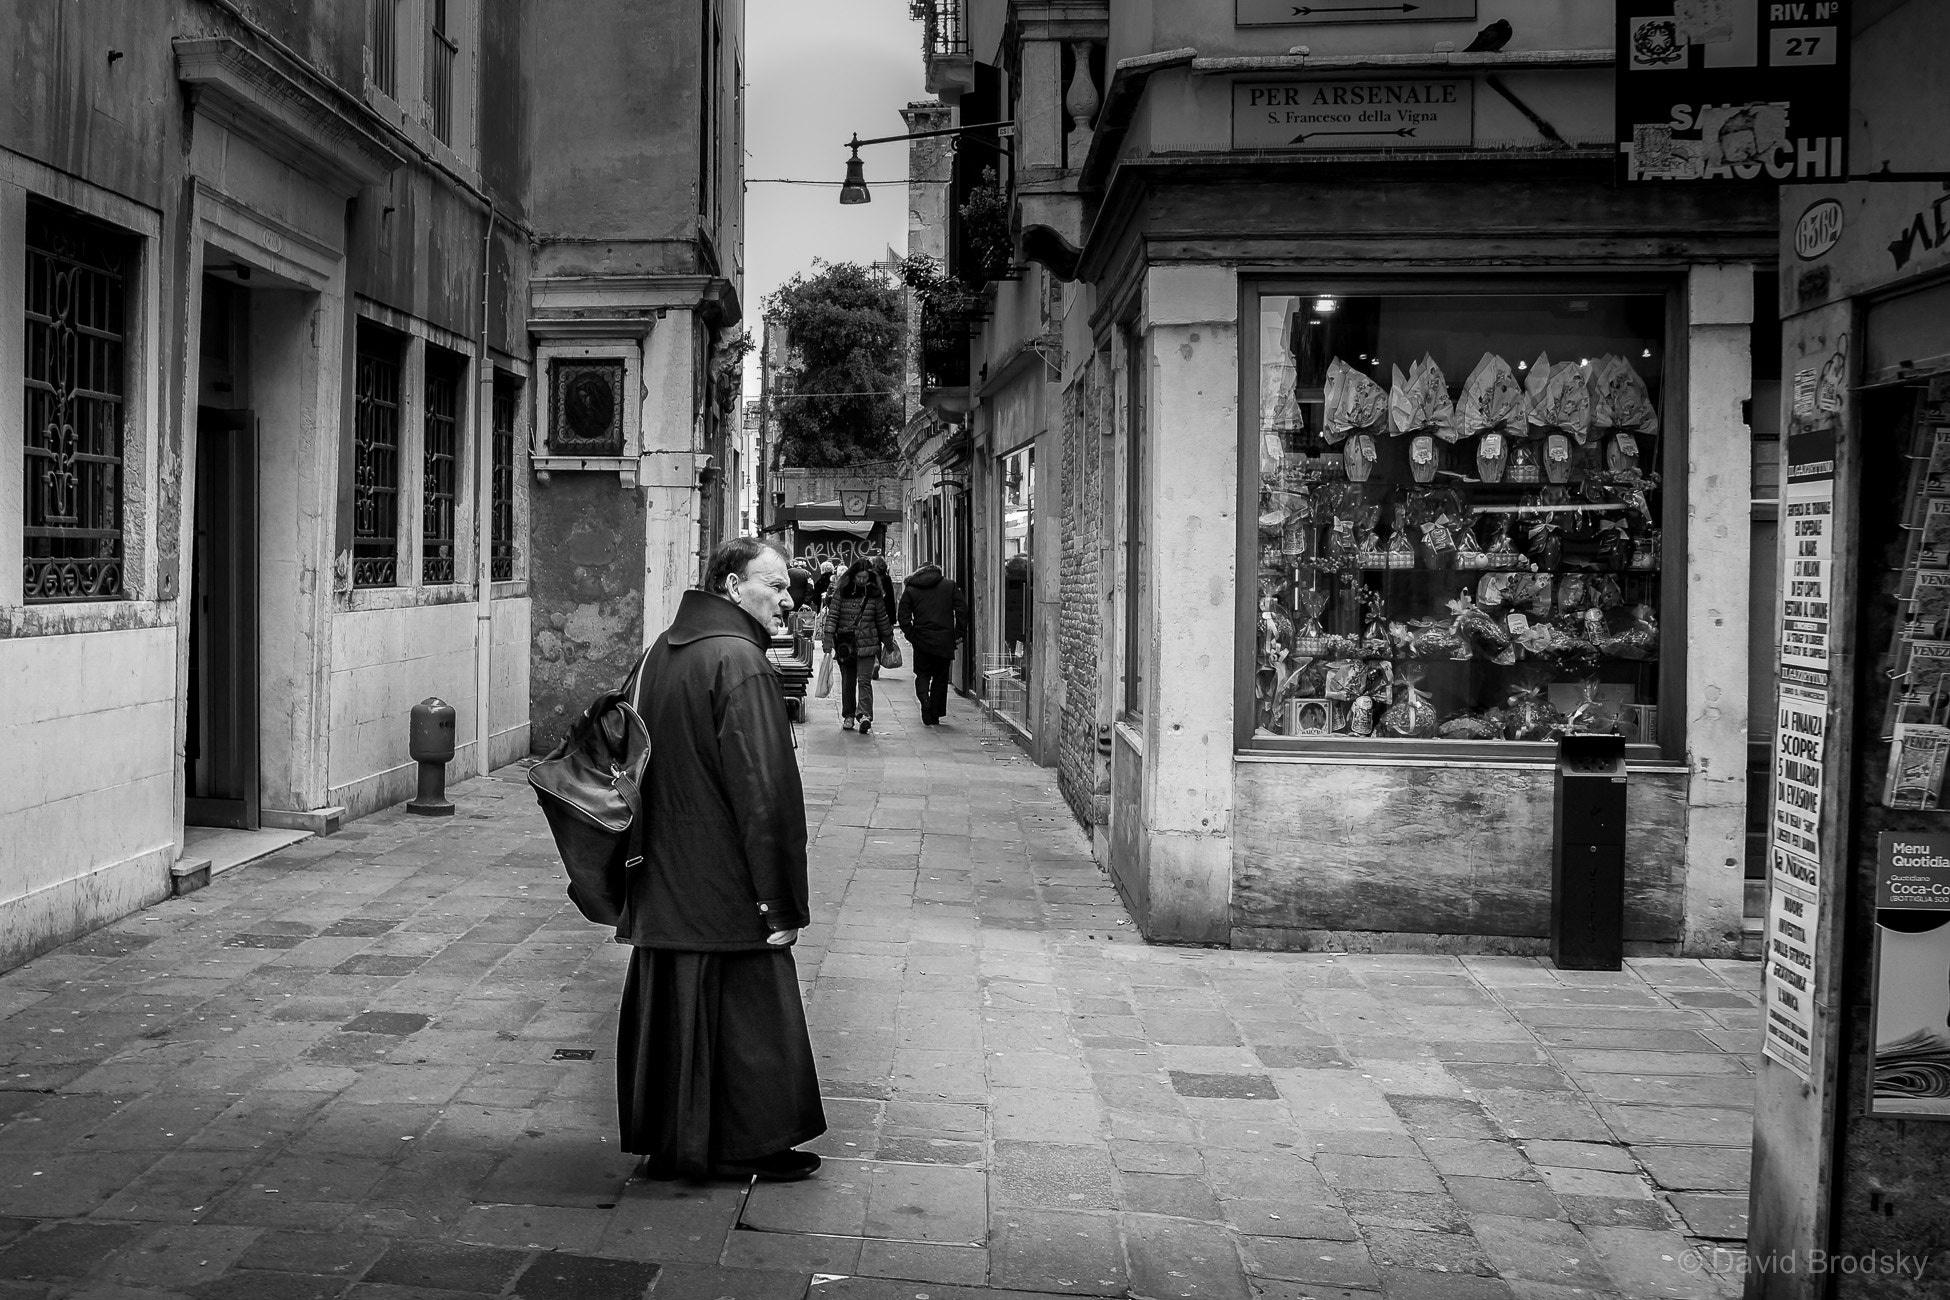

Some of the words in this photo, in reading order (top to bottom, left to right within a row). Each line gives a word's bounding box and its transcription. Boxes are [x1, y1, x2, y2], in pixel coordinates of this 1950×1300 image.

[1769, 3, 1809, 21] RIV.
[1785, 37, 1821, 57] 27
[1249, 87, 1301, 107] PER
[1311, 84, 1457, 106] ARSENALE
[1267, 112, 1281, 124] S.
[1286, 111, 1351, 124] Francesco
[1358, 110, 1392, 123] della
[1396, 109, 1438, 125] Vigna
[1800, 690, 1826, 701] FRANCESCO
[1780, 708, 1789, 730] LA
[1791, 711, 1823, 738] FINANZA
[1781, 733, 1820, 762] SCOPRE
[1778, 757, 1784, 777] 5
[1785, 759, 1820, 789] MILIARDI
[1778, 781, 1786, 803] DI
[1786, 784, 1819, 815] EVASIONE
[1892, 842, 1930, 855] Menu
[1775, 849, 1783, 872] la
[1785, 853, 1817, 887] Nuova
[1890, 882, 1950, 895] Coca-Co
